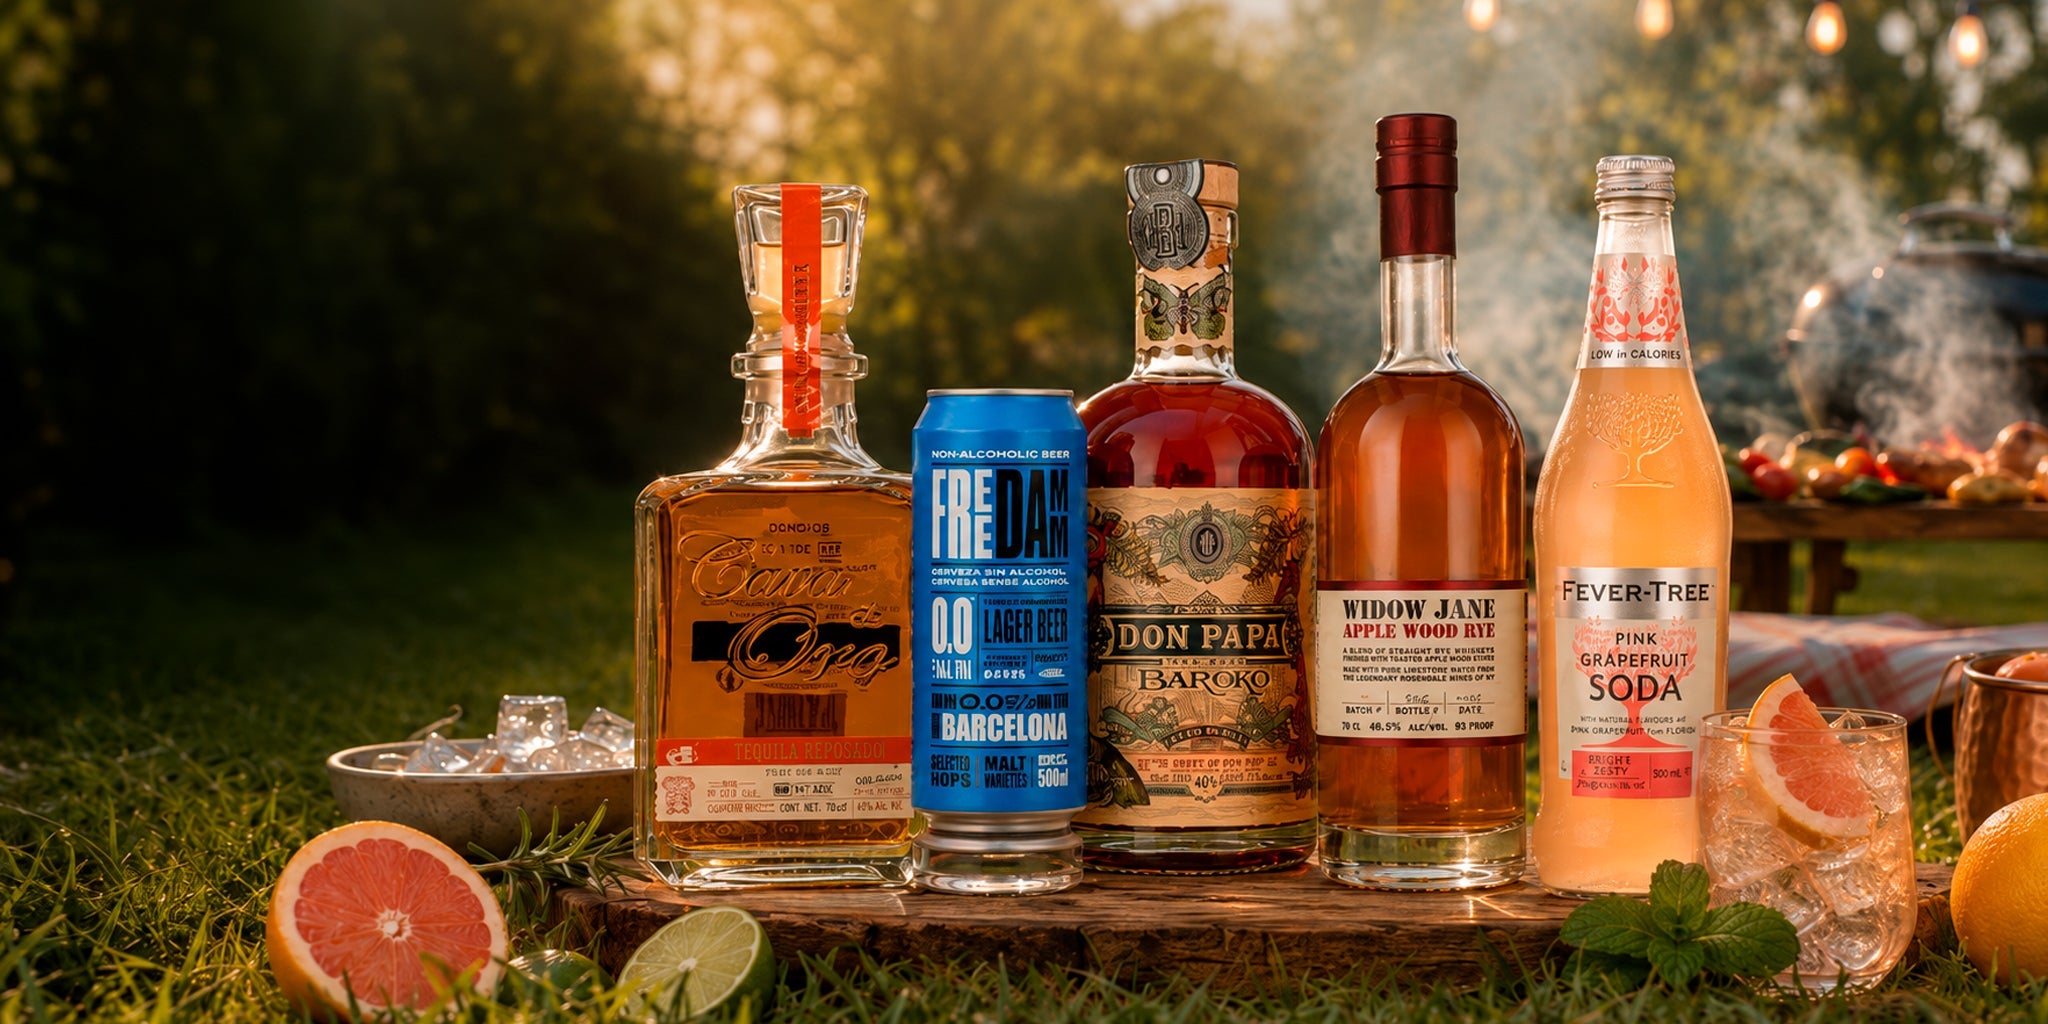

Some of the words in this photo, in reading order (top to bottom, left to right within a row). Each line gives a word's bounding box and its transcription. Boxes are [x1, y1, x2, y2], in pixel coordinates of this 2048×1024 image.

[1591, 350, 1613, 360] LOW
[1617, 349, 1627, 359] in
[1630, 349, 1681, 360] CALORIES
[932, 450, 1038, 459] NON-ALCOHOLIC
[1041, 450, 1070, 459] BEER
[931, 568, 981, 576] CERVEZA
[1562, 580, 1710, 602] FEVER-TREE
[1343, 599, 1426, 620] WIDOW
[1434, 599, 1495, 619] JANE
[932, 596, 973, 655] 0.0
[984, 609, 1033, 644] LAGER
[1037, 608, 1068, 643] BEER
[1343, 623, 1396, 639] APPLE
[1402, 623, 1458, 639] WOOD
[1464, 622, 1495, 638] RYE
[1118, 623, 1190, 650] DON
[1201, 623, 1280, 649] PAPA
[1616, 632, 1657, 645] PINK
[1343, 647, 1348, 655] A
[1580, 653, 1688, 668] GRAPEFRUIT
[1138, 668, 1271, 696] BAROKO
[1589, 674, 1682, 701] SODA
[1346, 706, 1373, 714] BATCH
[1395, 706, 1430, 714] BOTTLE
[942, 712, 1068, 742] BARCELONA
[1455, 721, 1466, 731] 93
[1469, 721, 1494, 731] PROOF
[734, 742, 799, 762] TEQUILA
[931, 753, 970, 771] SELECTED
[984, 756, 1027, 771] MALT
[931, 772, 971, 787] HOPS
[984, 772, 1028, 788] VARIETIES
